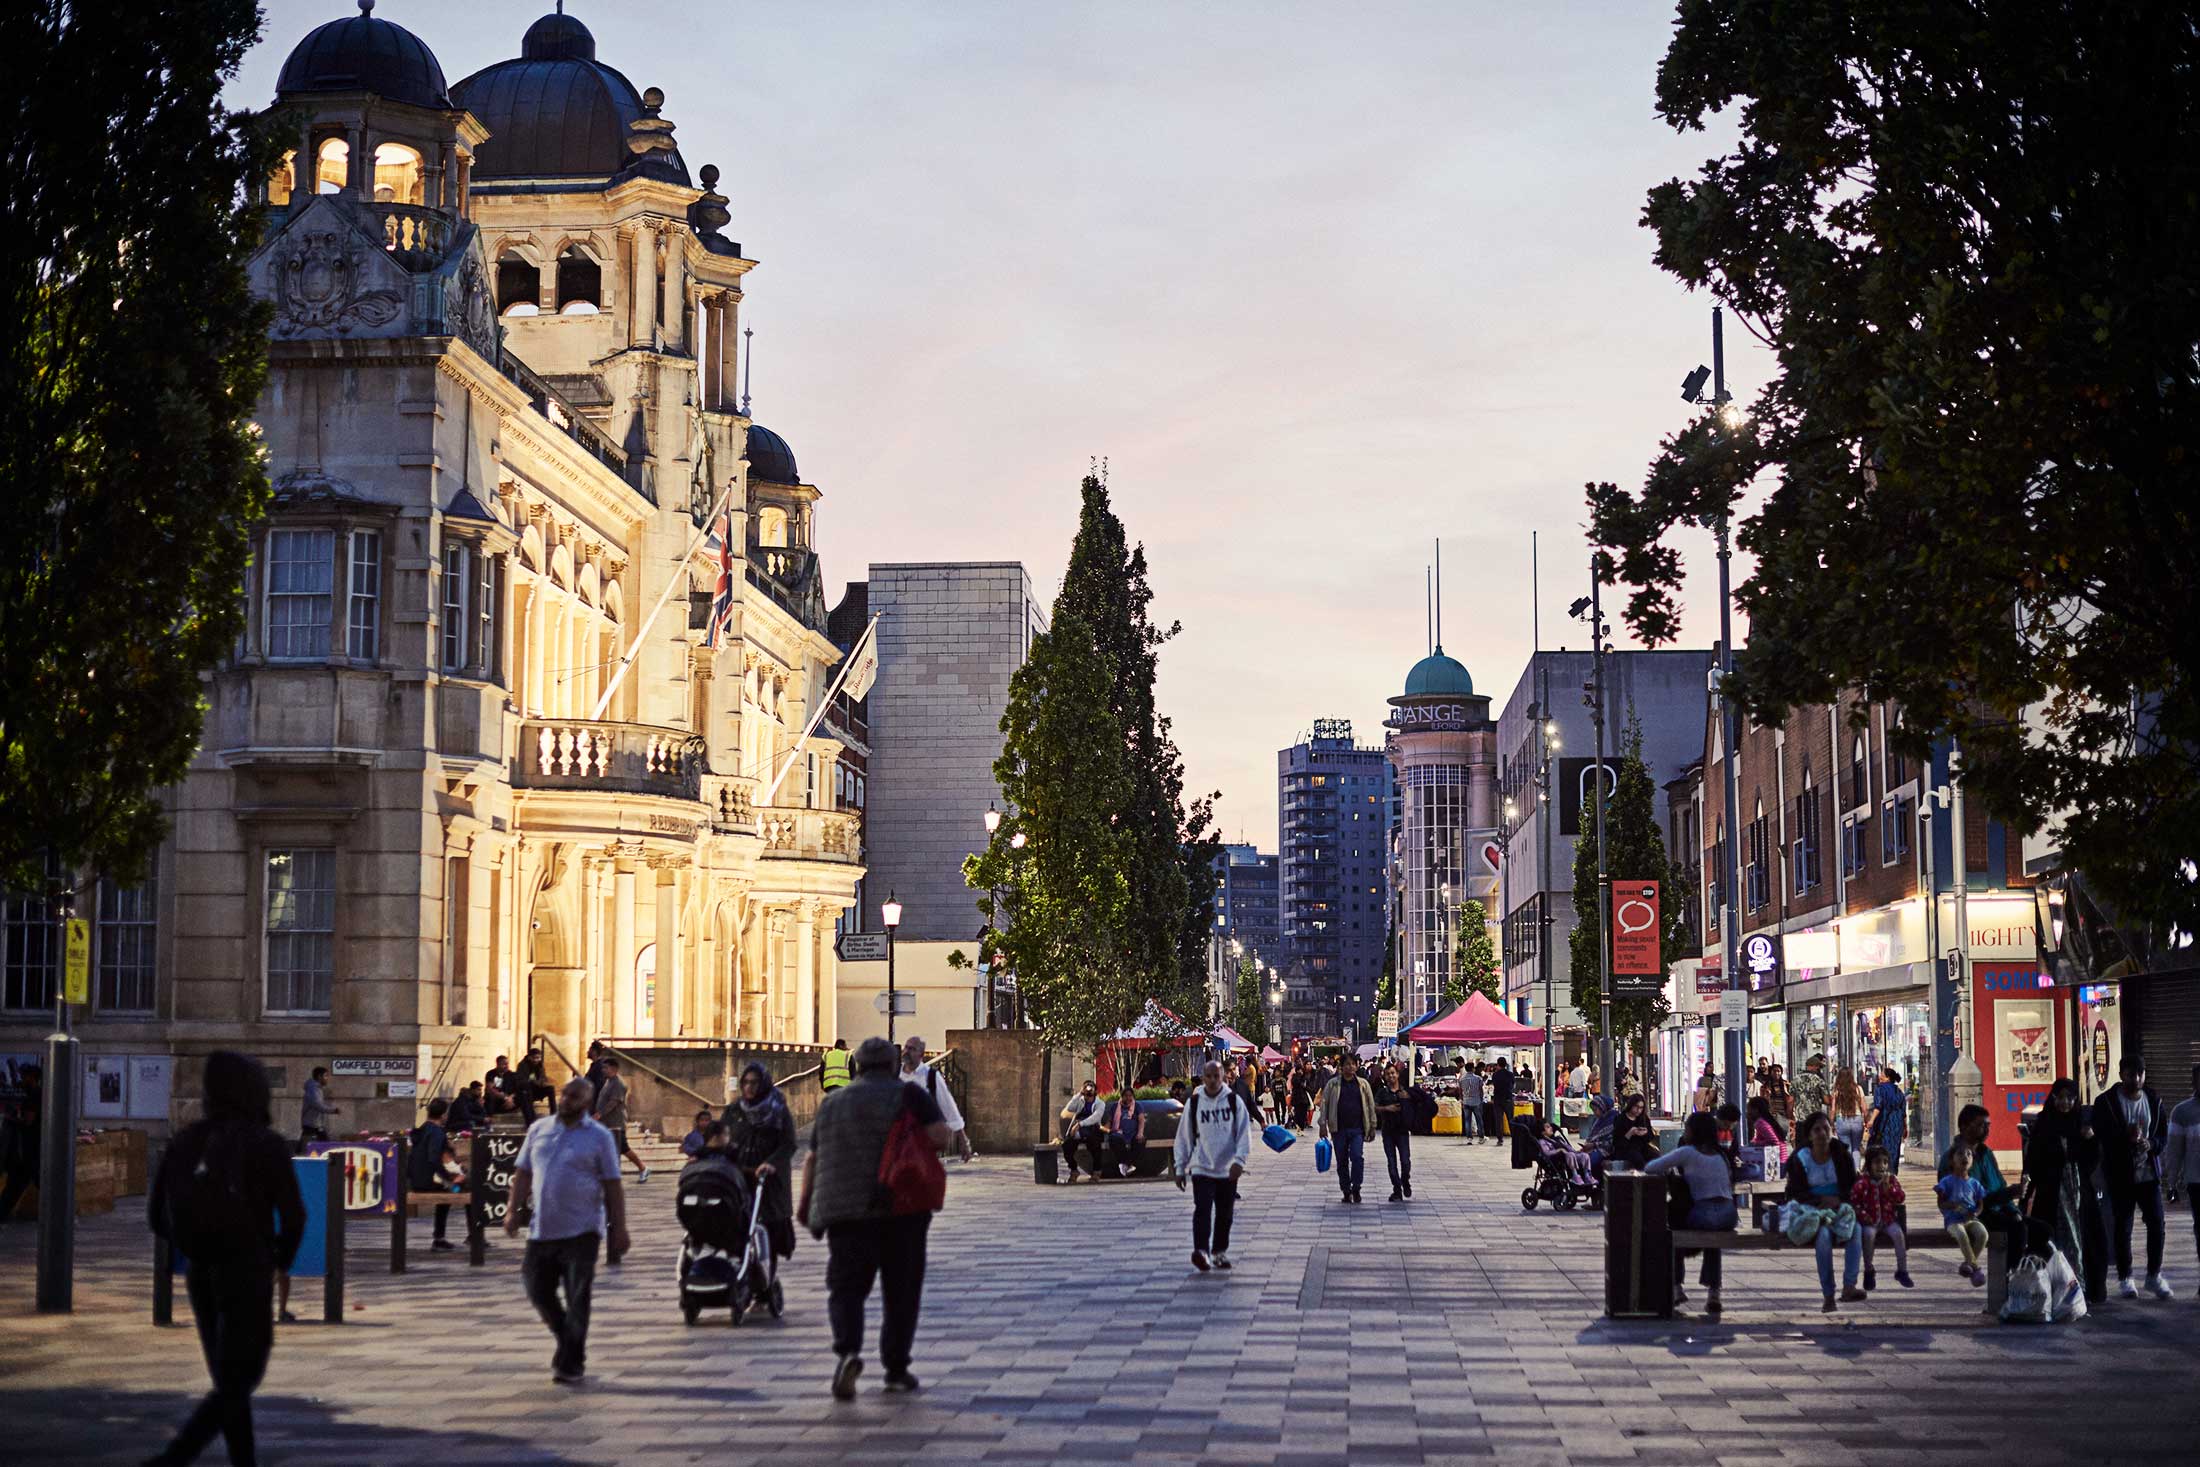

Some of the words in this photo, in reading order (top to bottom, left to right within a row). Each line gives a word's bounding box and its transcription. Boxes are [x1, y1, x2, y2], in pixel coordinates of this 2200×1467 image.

[334, 1061, 382, 1070] OAKFIELD
[384, 1061, 412, 1070] ROAD
[1200, 1107, 1231, 1124] NYU
[488, 1138, 518, 1157] tic
